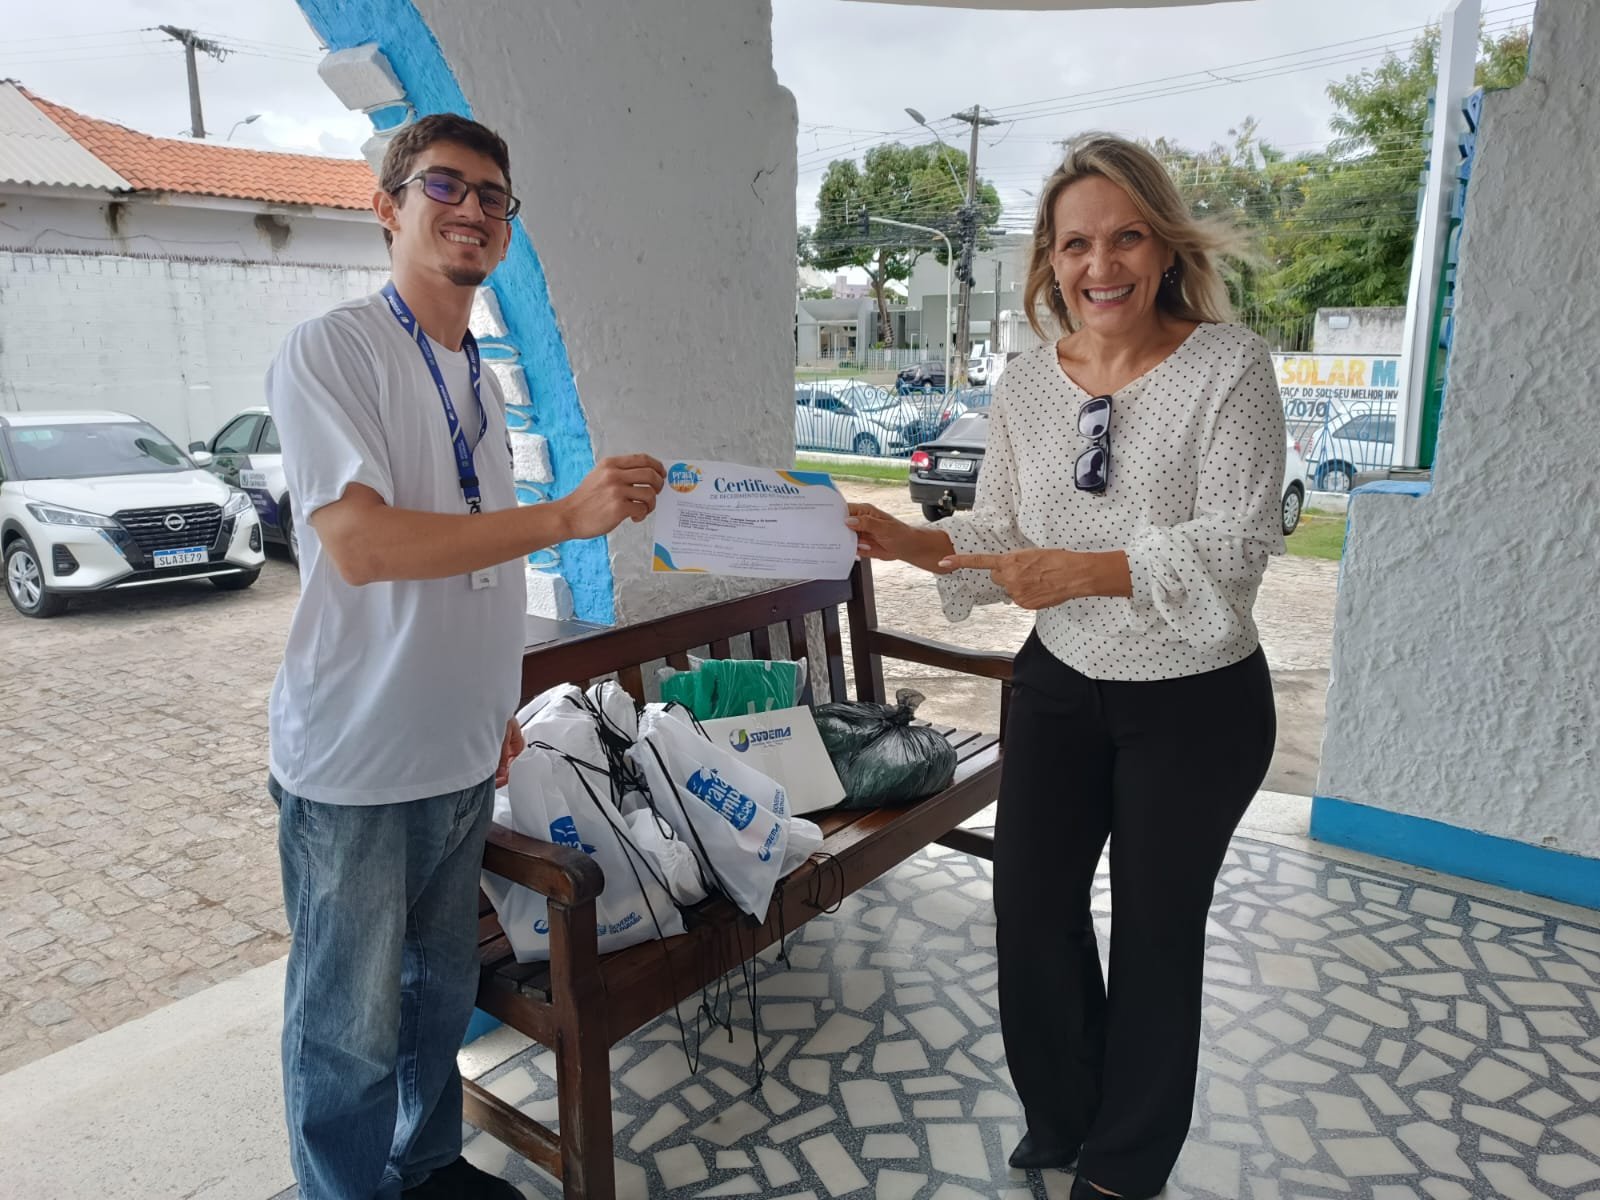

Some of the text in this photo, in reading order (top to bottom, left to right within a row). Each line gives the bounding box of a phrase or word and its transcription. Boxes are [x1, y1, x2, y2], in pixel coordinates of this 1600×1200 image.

[1280, 359, 1399, 387] SOLAR M
[1302, 387, 1314, 398] DO
[1334, 388, 1350, 398] SEU
[1350, 388, 1383, 400] MELHOR
[714, 477, 800, 495] Certificado
[750, 727, 791, 743] SUDEMA
[703, 778, 728, 810] raia
[719, 788, 742, 821] imp
